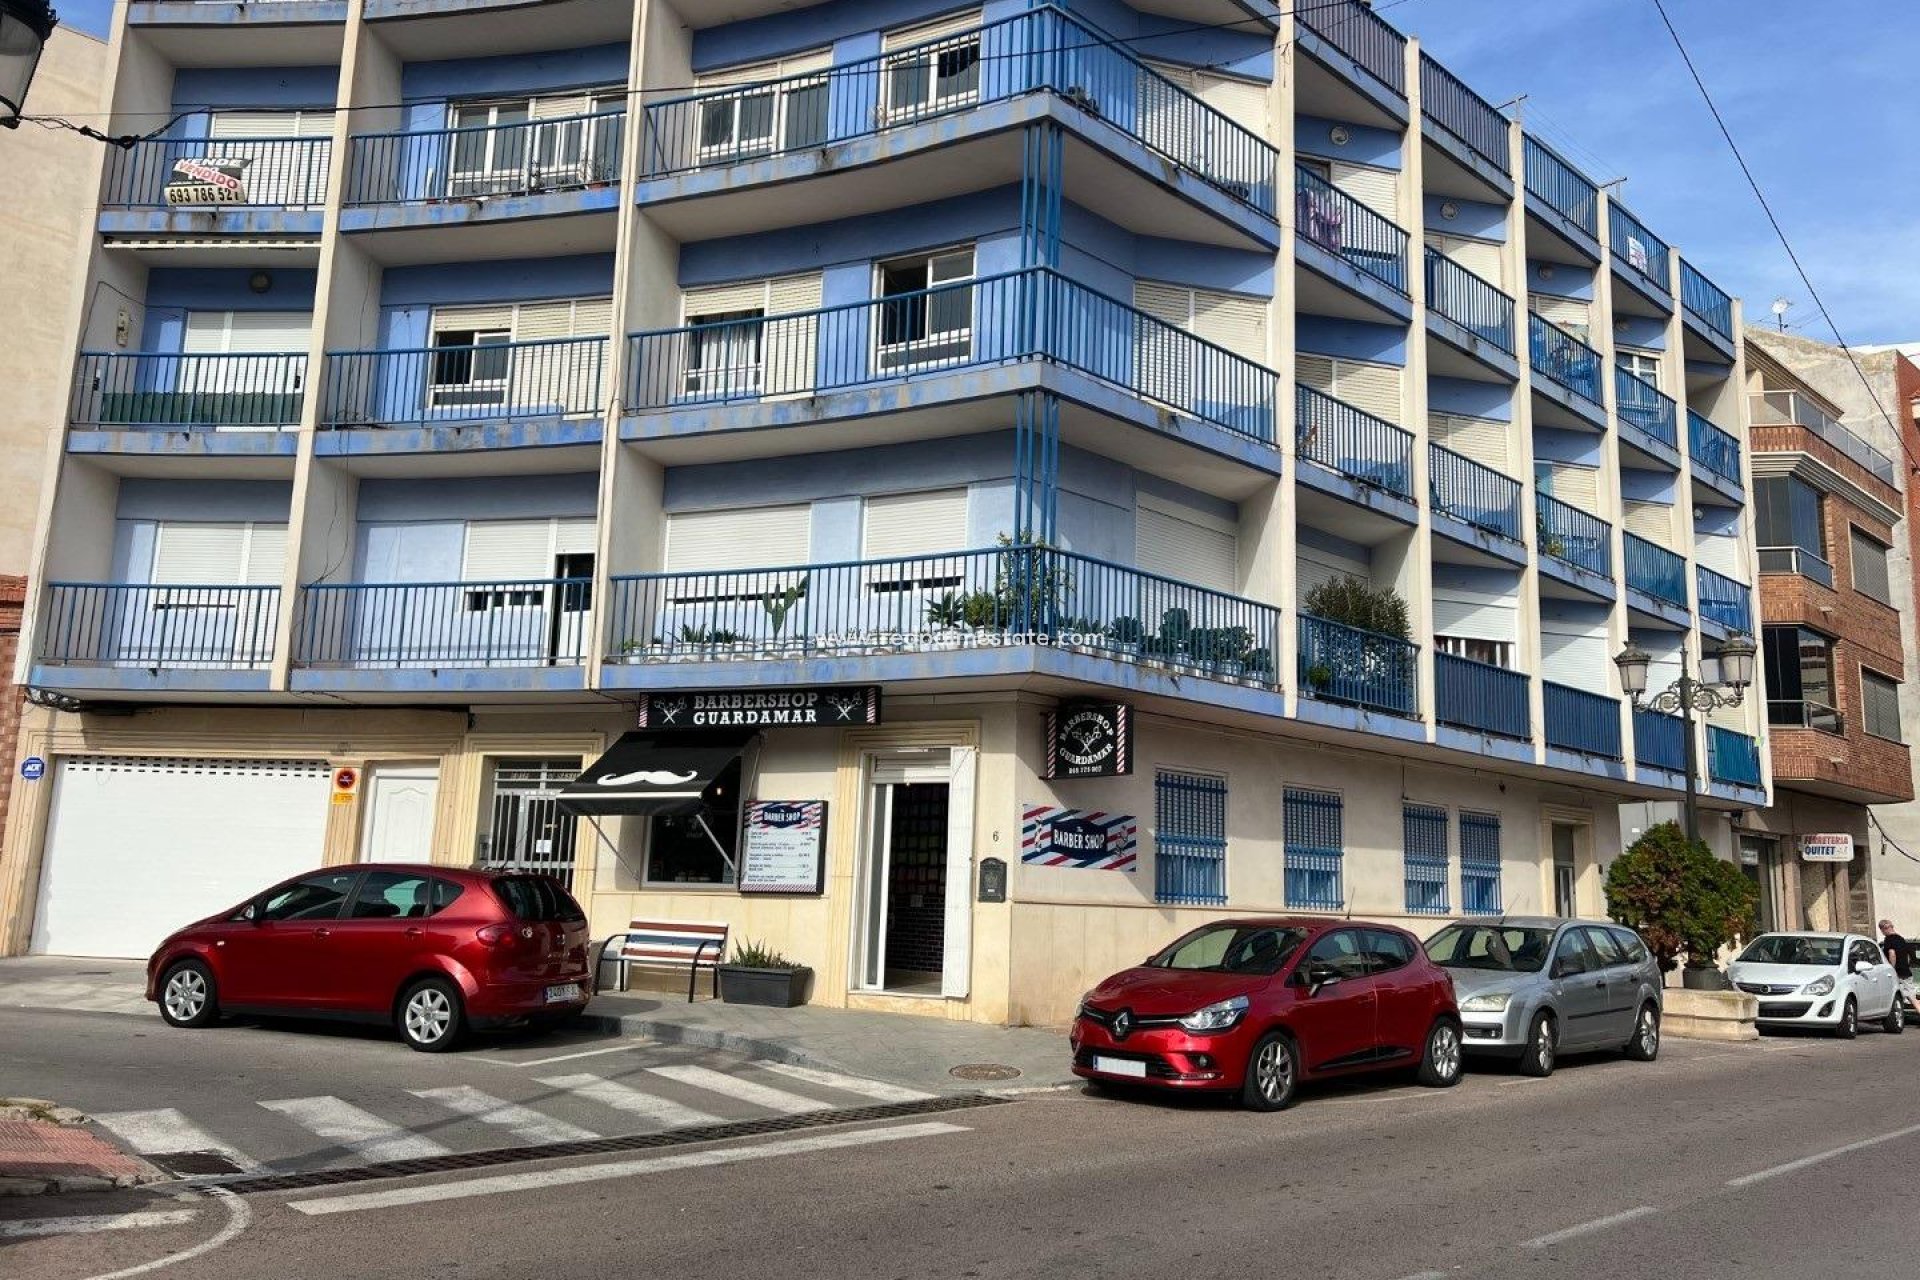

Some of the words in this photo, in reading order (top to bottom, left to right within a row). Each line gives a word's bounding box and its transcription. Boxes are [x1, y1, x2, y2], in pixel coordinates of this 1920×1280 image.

[179, 162, 238, 189] VENDIDO
[169, 188, 191, 203] 693
[193, 187, 216, 202] 786
[694, 692, 818, 709] BARBERSHOP
[693, 709, 817, 725] GUARDAMAR
[1060, 711, 1114, 741] BARBERSHOP
[1060, 743, 1114, 765] GUARDAMAR
[992, 830, 1000, 842] 6
[1054, 828, 1083, 849] BARBER
[1084, 833, 1105, 849] SHOP
[1804, 846, 1836, 855] QUITET
